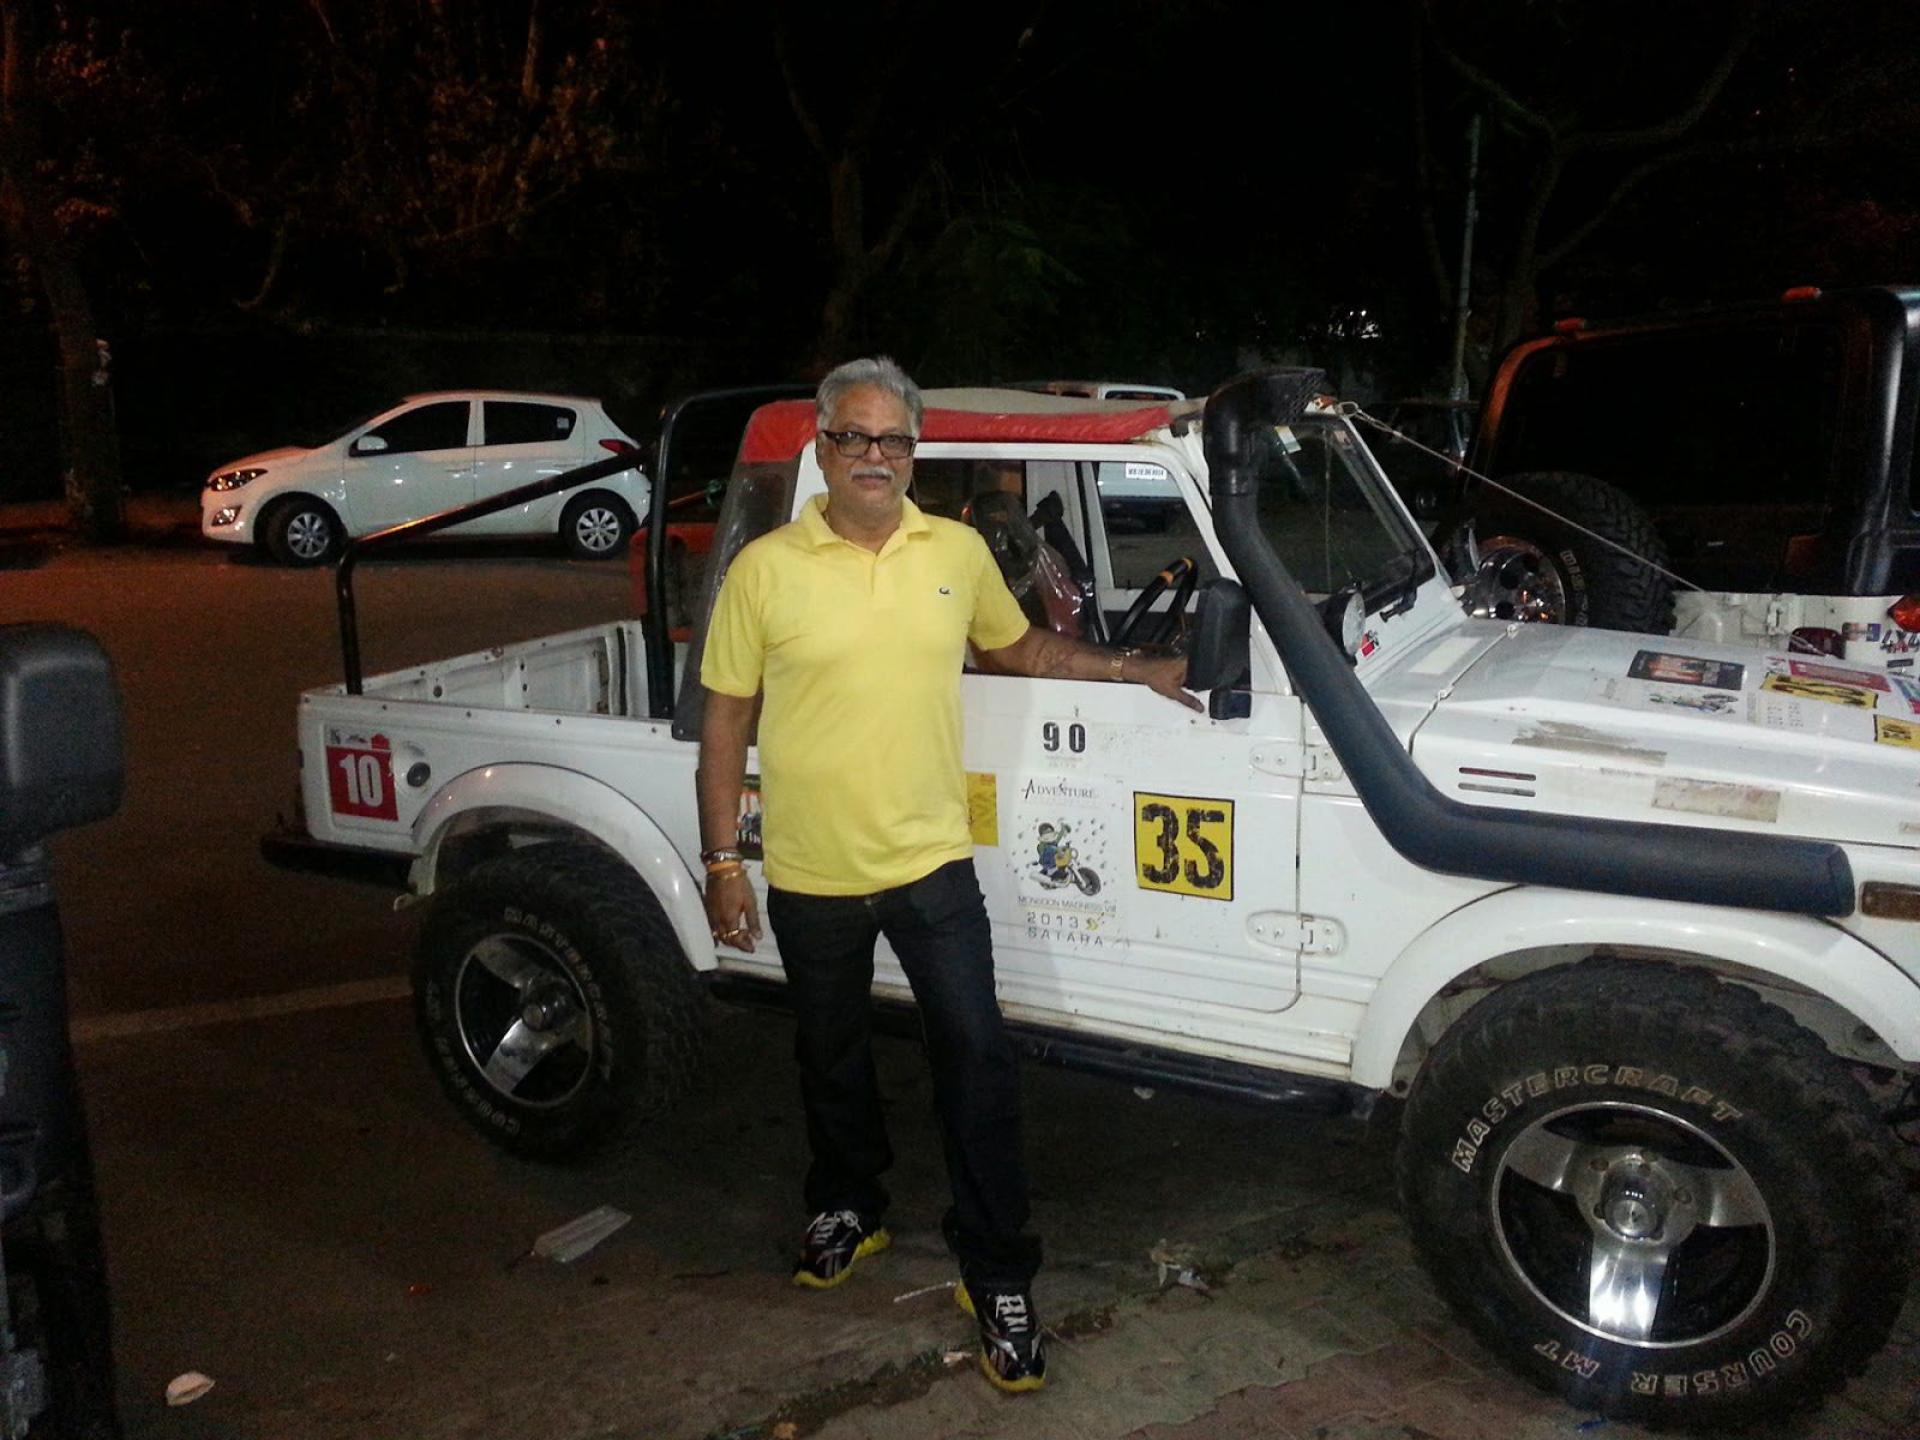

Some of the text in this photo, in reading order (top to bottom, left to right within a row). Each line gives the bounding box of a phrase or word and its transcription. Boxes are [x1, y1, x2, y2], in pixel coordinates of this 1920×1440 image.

[1043, 721, 1086, 753] 90
[339, 754, 384, 807] 10
[1142, 803, 1225, 889] 35
[1027, 912, 1079, 929] 2013
[1452, 1063, 1744, 1174] MASTERCRAFT
[1533, 1309, 1813, 1396] COURSER MT
